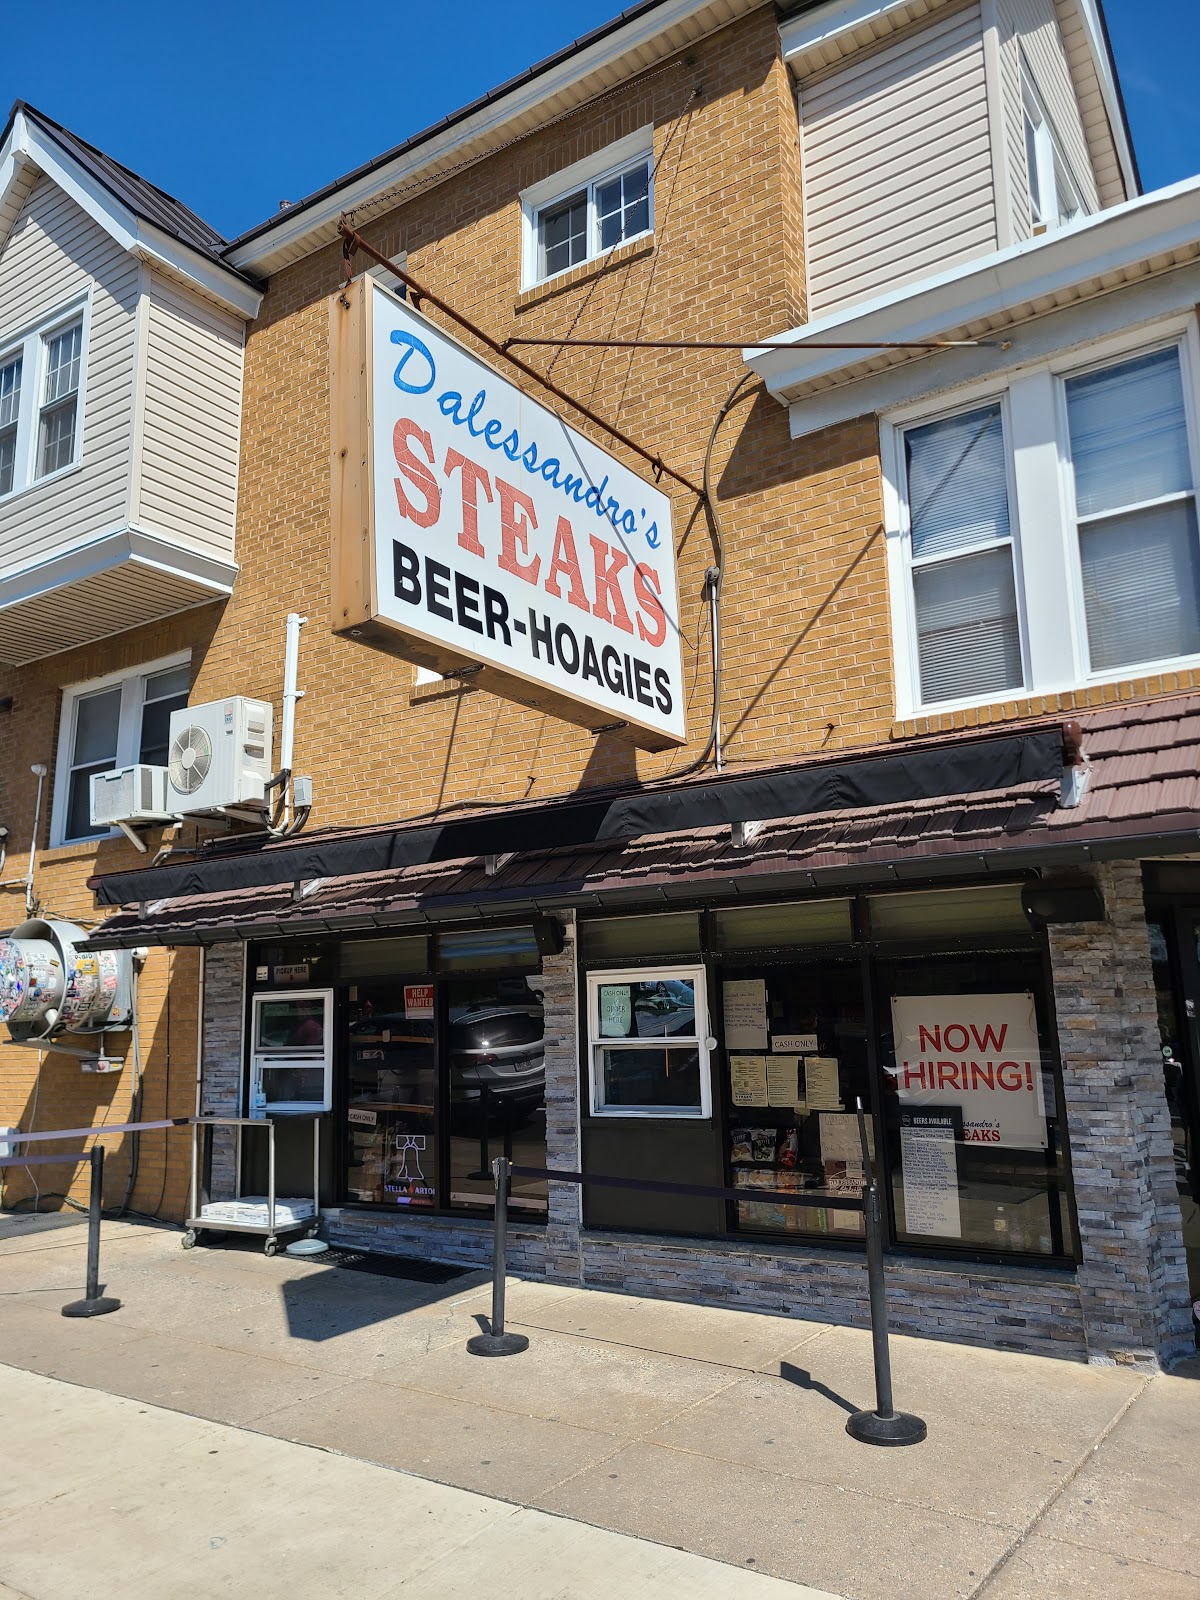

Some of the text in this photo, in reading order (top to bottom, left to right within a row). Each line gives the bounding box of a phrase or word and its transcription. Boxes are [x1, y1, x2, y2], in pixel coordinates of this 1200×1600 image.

[390, 329, 661, 549] Dalessandro's
[392, 417, 667, 648] STEAKS
[392, 538, 674, 715] BEER-HOAGIES
[294, 966, 307, 974] HERE
[412, 988, 429, 998] HELP
[407, 998, 434, 1007] WANTED
[606, 1005, 626, 1013] ORDER
[918, 1023, 1008, 1053] NOW
[774, 1039, 814, 1048] CASH ONLY
[903, 1061, 1034, 1092] HIRING!
[362, 1114, 375, 1122] ONLY
[962, 1119, 1001, 1128] ssandro's
[962, 1129, 1001, 1142] EAKS
[384, 1184, 436, 1195] STELLA ARTOI
